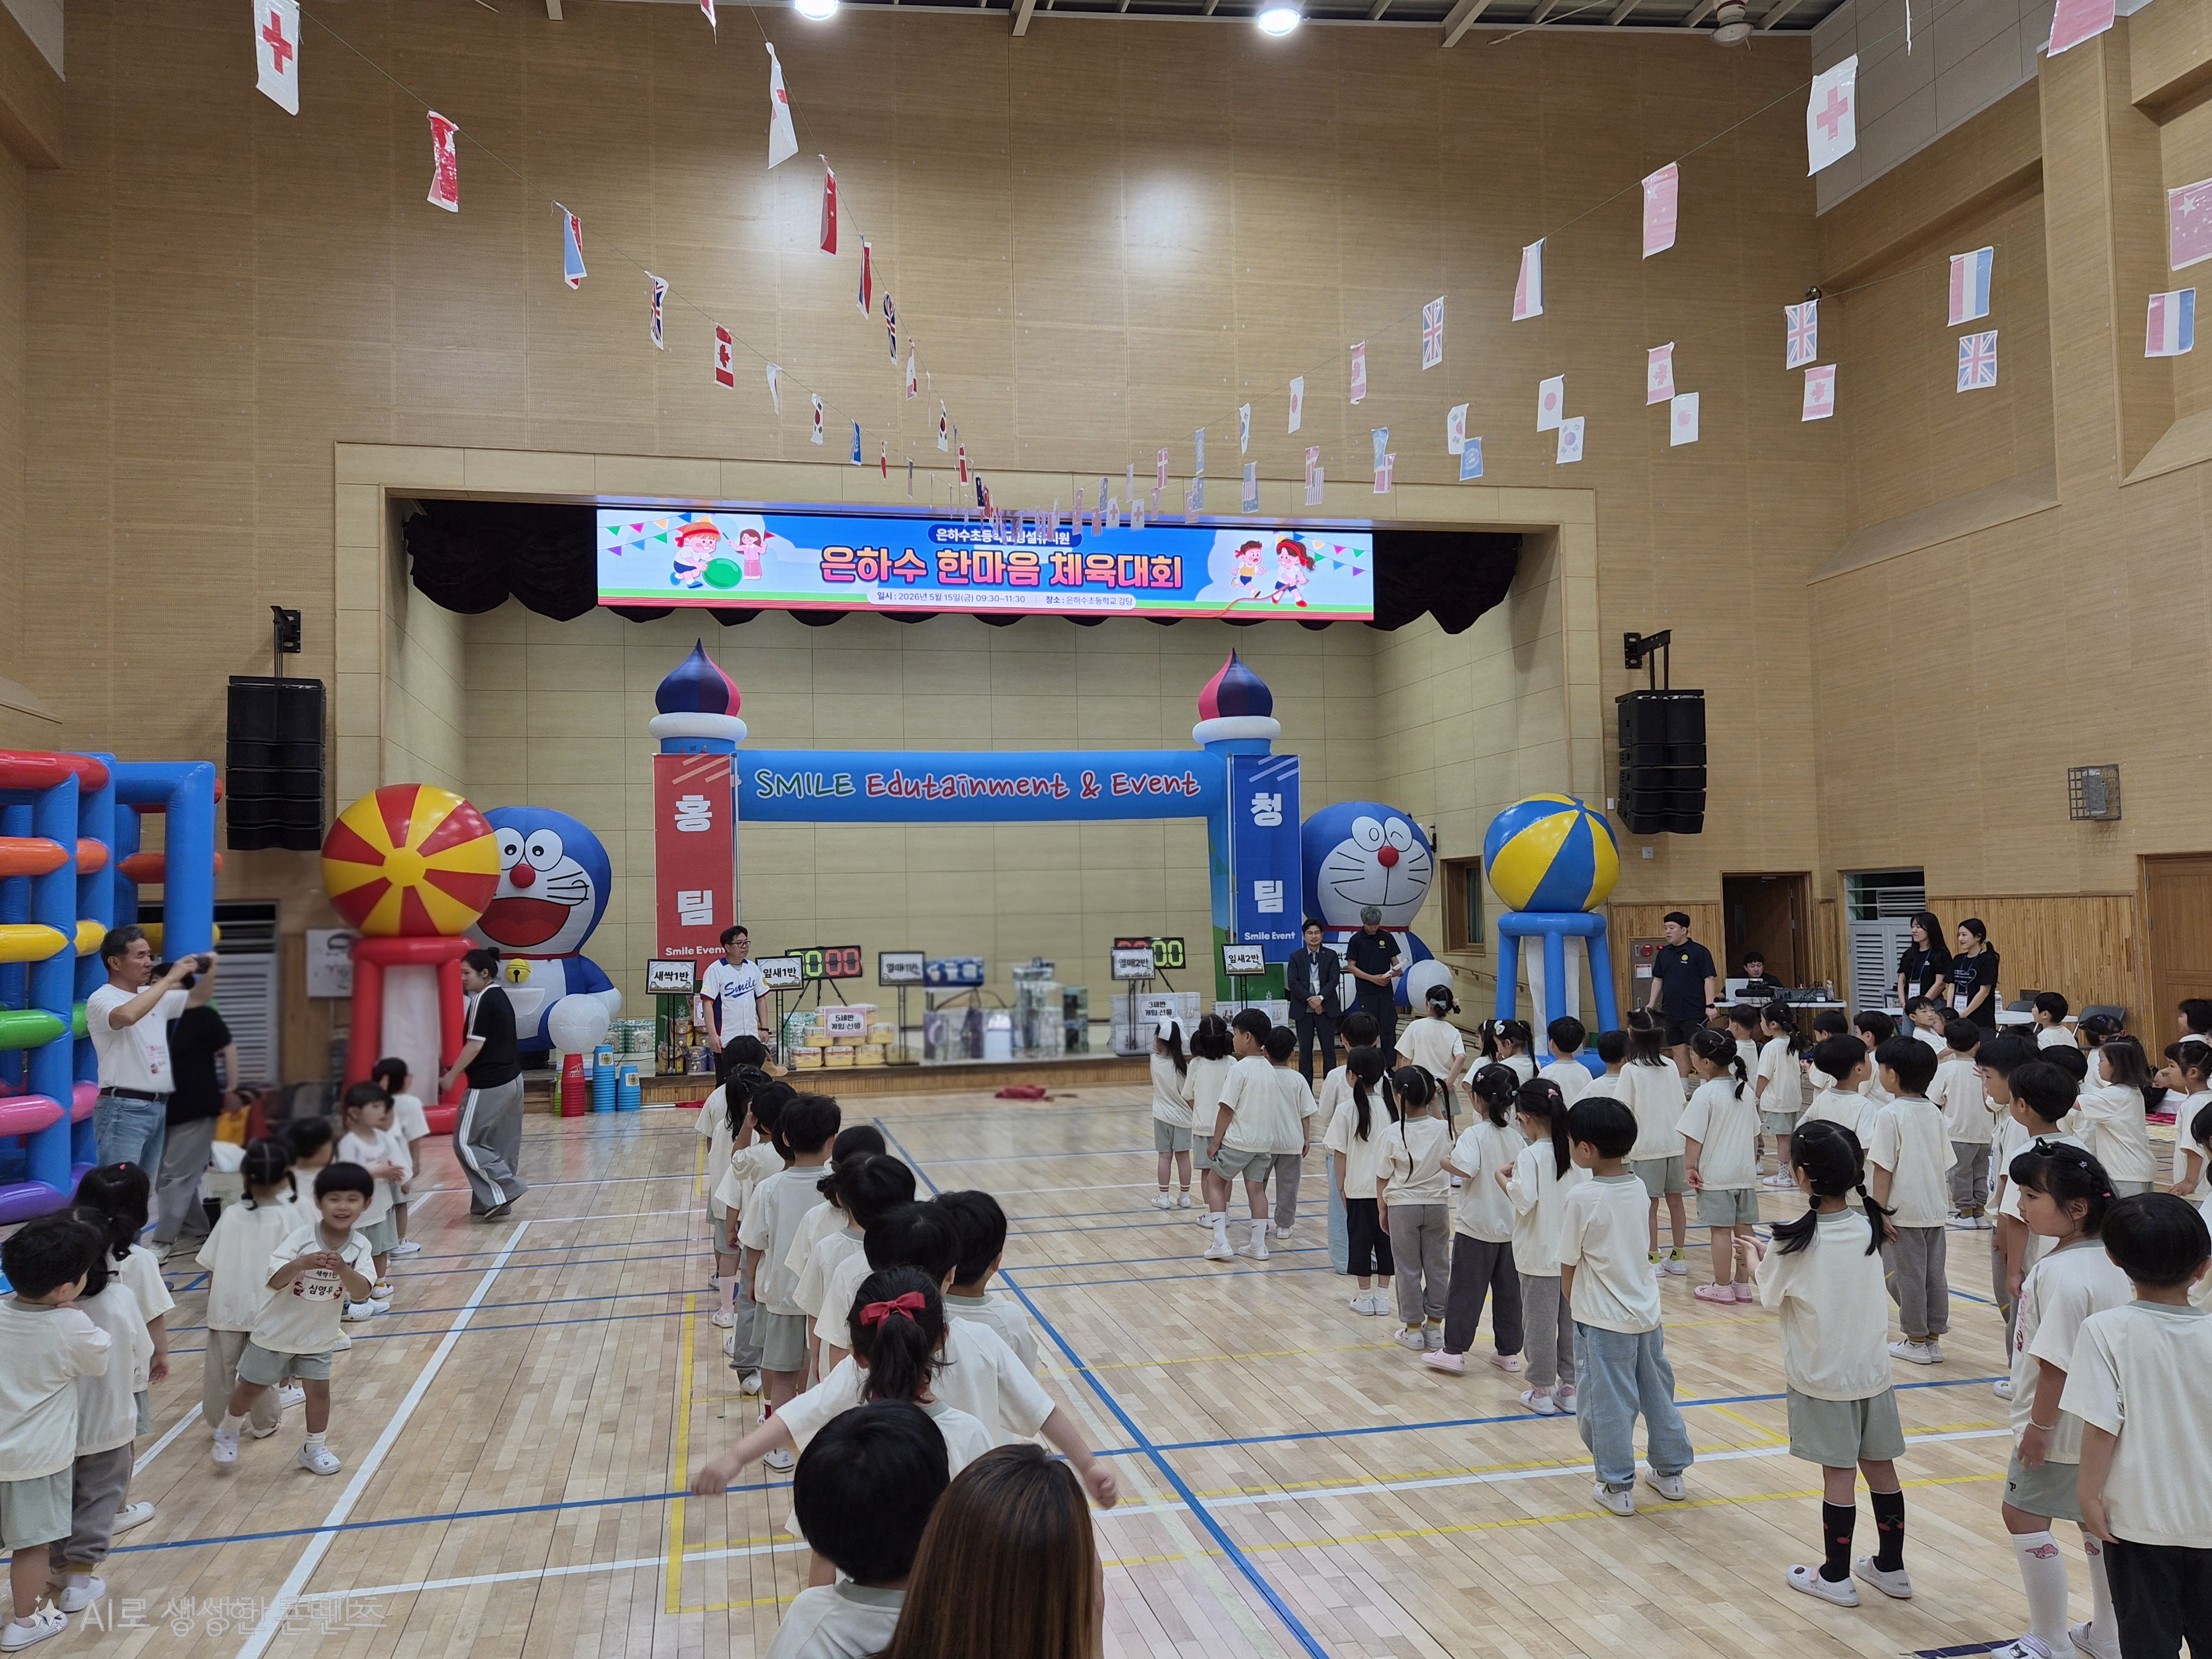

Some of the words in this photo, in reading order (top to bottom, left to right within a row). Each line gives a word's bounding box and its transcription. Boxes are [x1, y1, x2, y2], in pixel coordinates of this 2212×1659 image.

[821, 545, 928, 583] 은하수
[936, 549, 1041, 586] 한마음
[1049, 551, 1182, 588] 체육대회
[877, 592, 892, 601] 일시
[899, 592, 927, 601] 2026년
[930, 593, 942, 602] 5월
[944, 593, 974, 603] 15일(금)
[975, 594, 1025, 603] 09:30~11:30
[1046, 595, 1061, 604] 장소
[1066, 596, 1117, 605] 은하수초등학교
[755, 768, 856, 800] SMILE
[865, 768, 1070, 800] Edutainment
[1080, 769, 1102, 800] &
[1111, 771, 1201, 797] Event
[1244, 931, 1270, 941] Smile
[1271, 931, 1296, 940] Event
[665, 946, 695, 956] Smile
[1118, 958, 1149, 968] 열매2반
[1228, 953, 1260, 964] 잎새2반
[654, 971, 690, 982] 새싹1반
[763, 967, 797, 978] 잎새1반
[724, 977, 757, 997] Smile
[308, 1284, 333, 1296] 심영우
